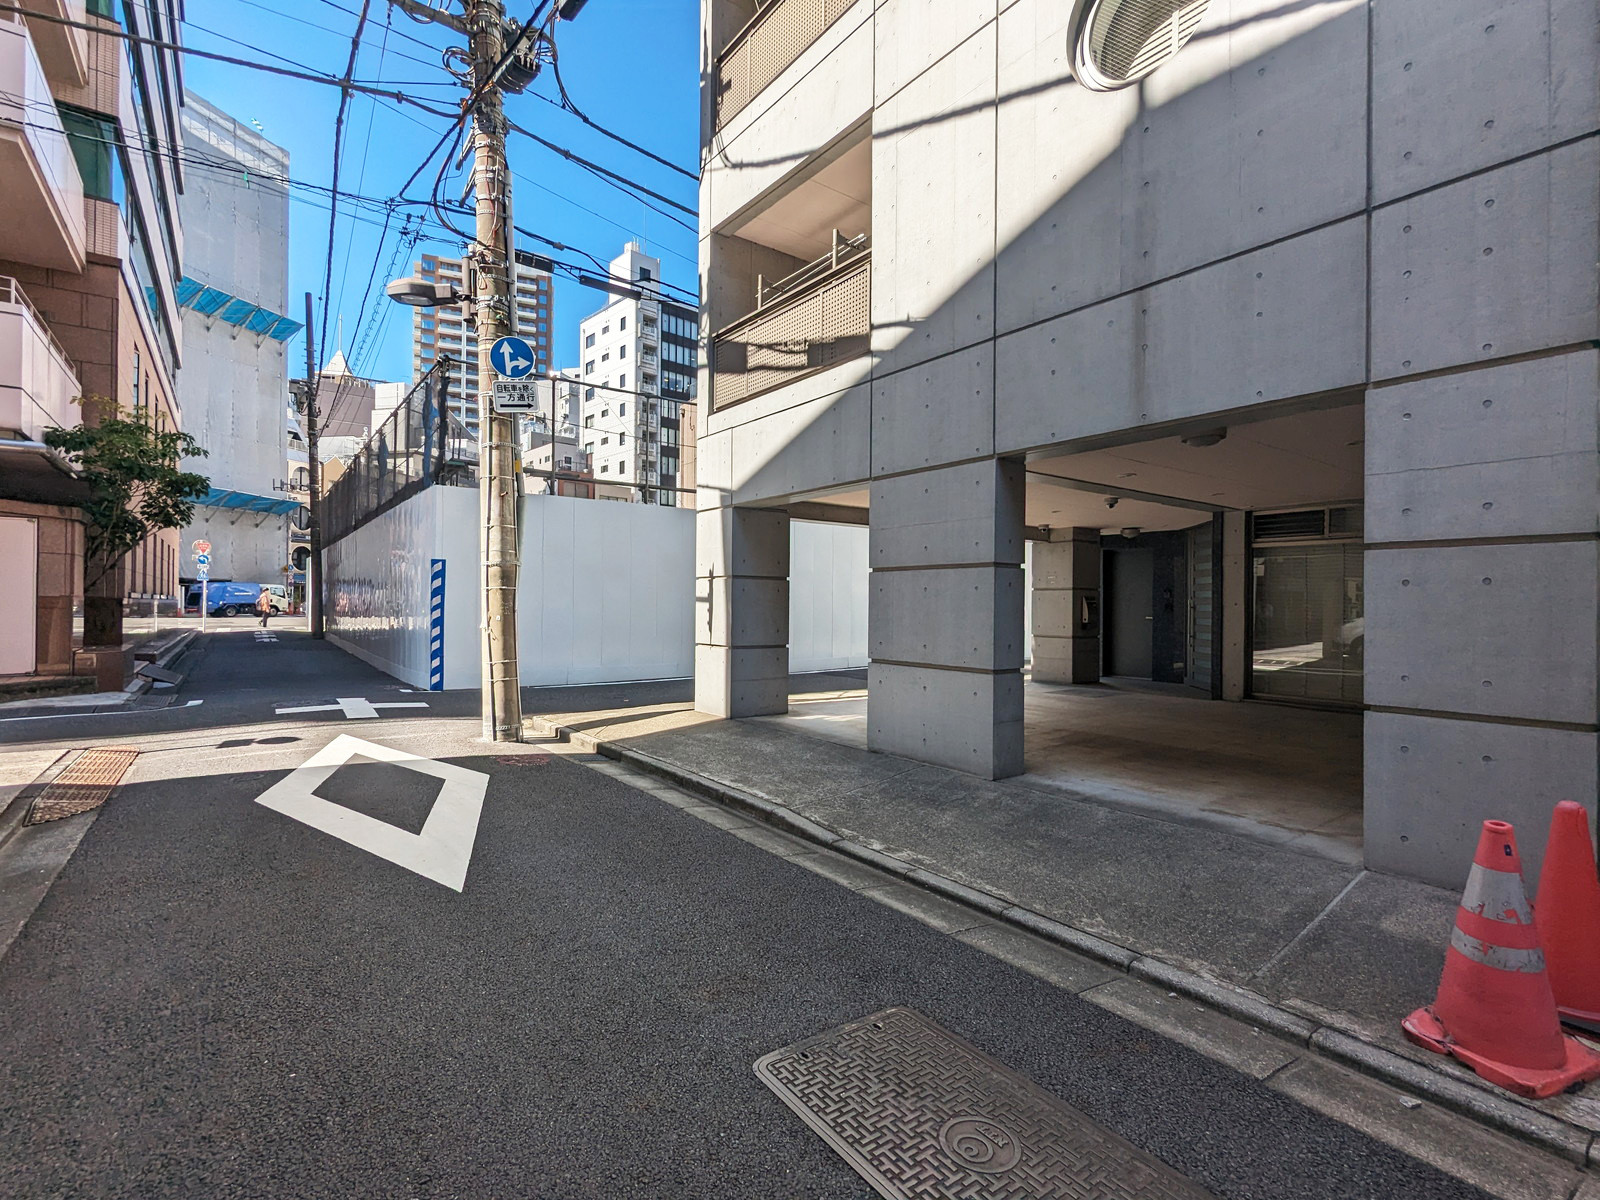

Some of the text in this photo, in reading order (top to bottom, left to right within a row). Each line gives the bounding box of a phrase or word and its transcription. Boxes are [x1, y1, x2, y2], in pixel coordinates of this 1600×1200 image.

[496, 384, 534, 392] 自転車を除く
[497, 393, 535, 401] 一方通行
